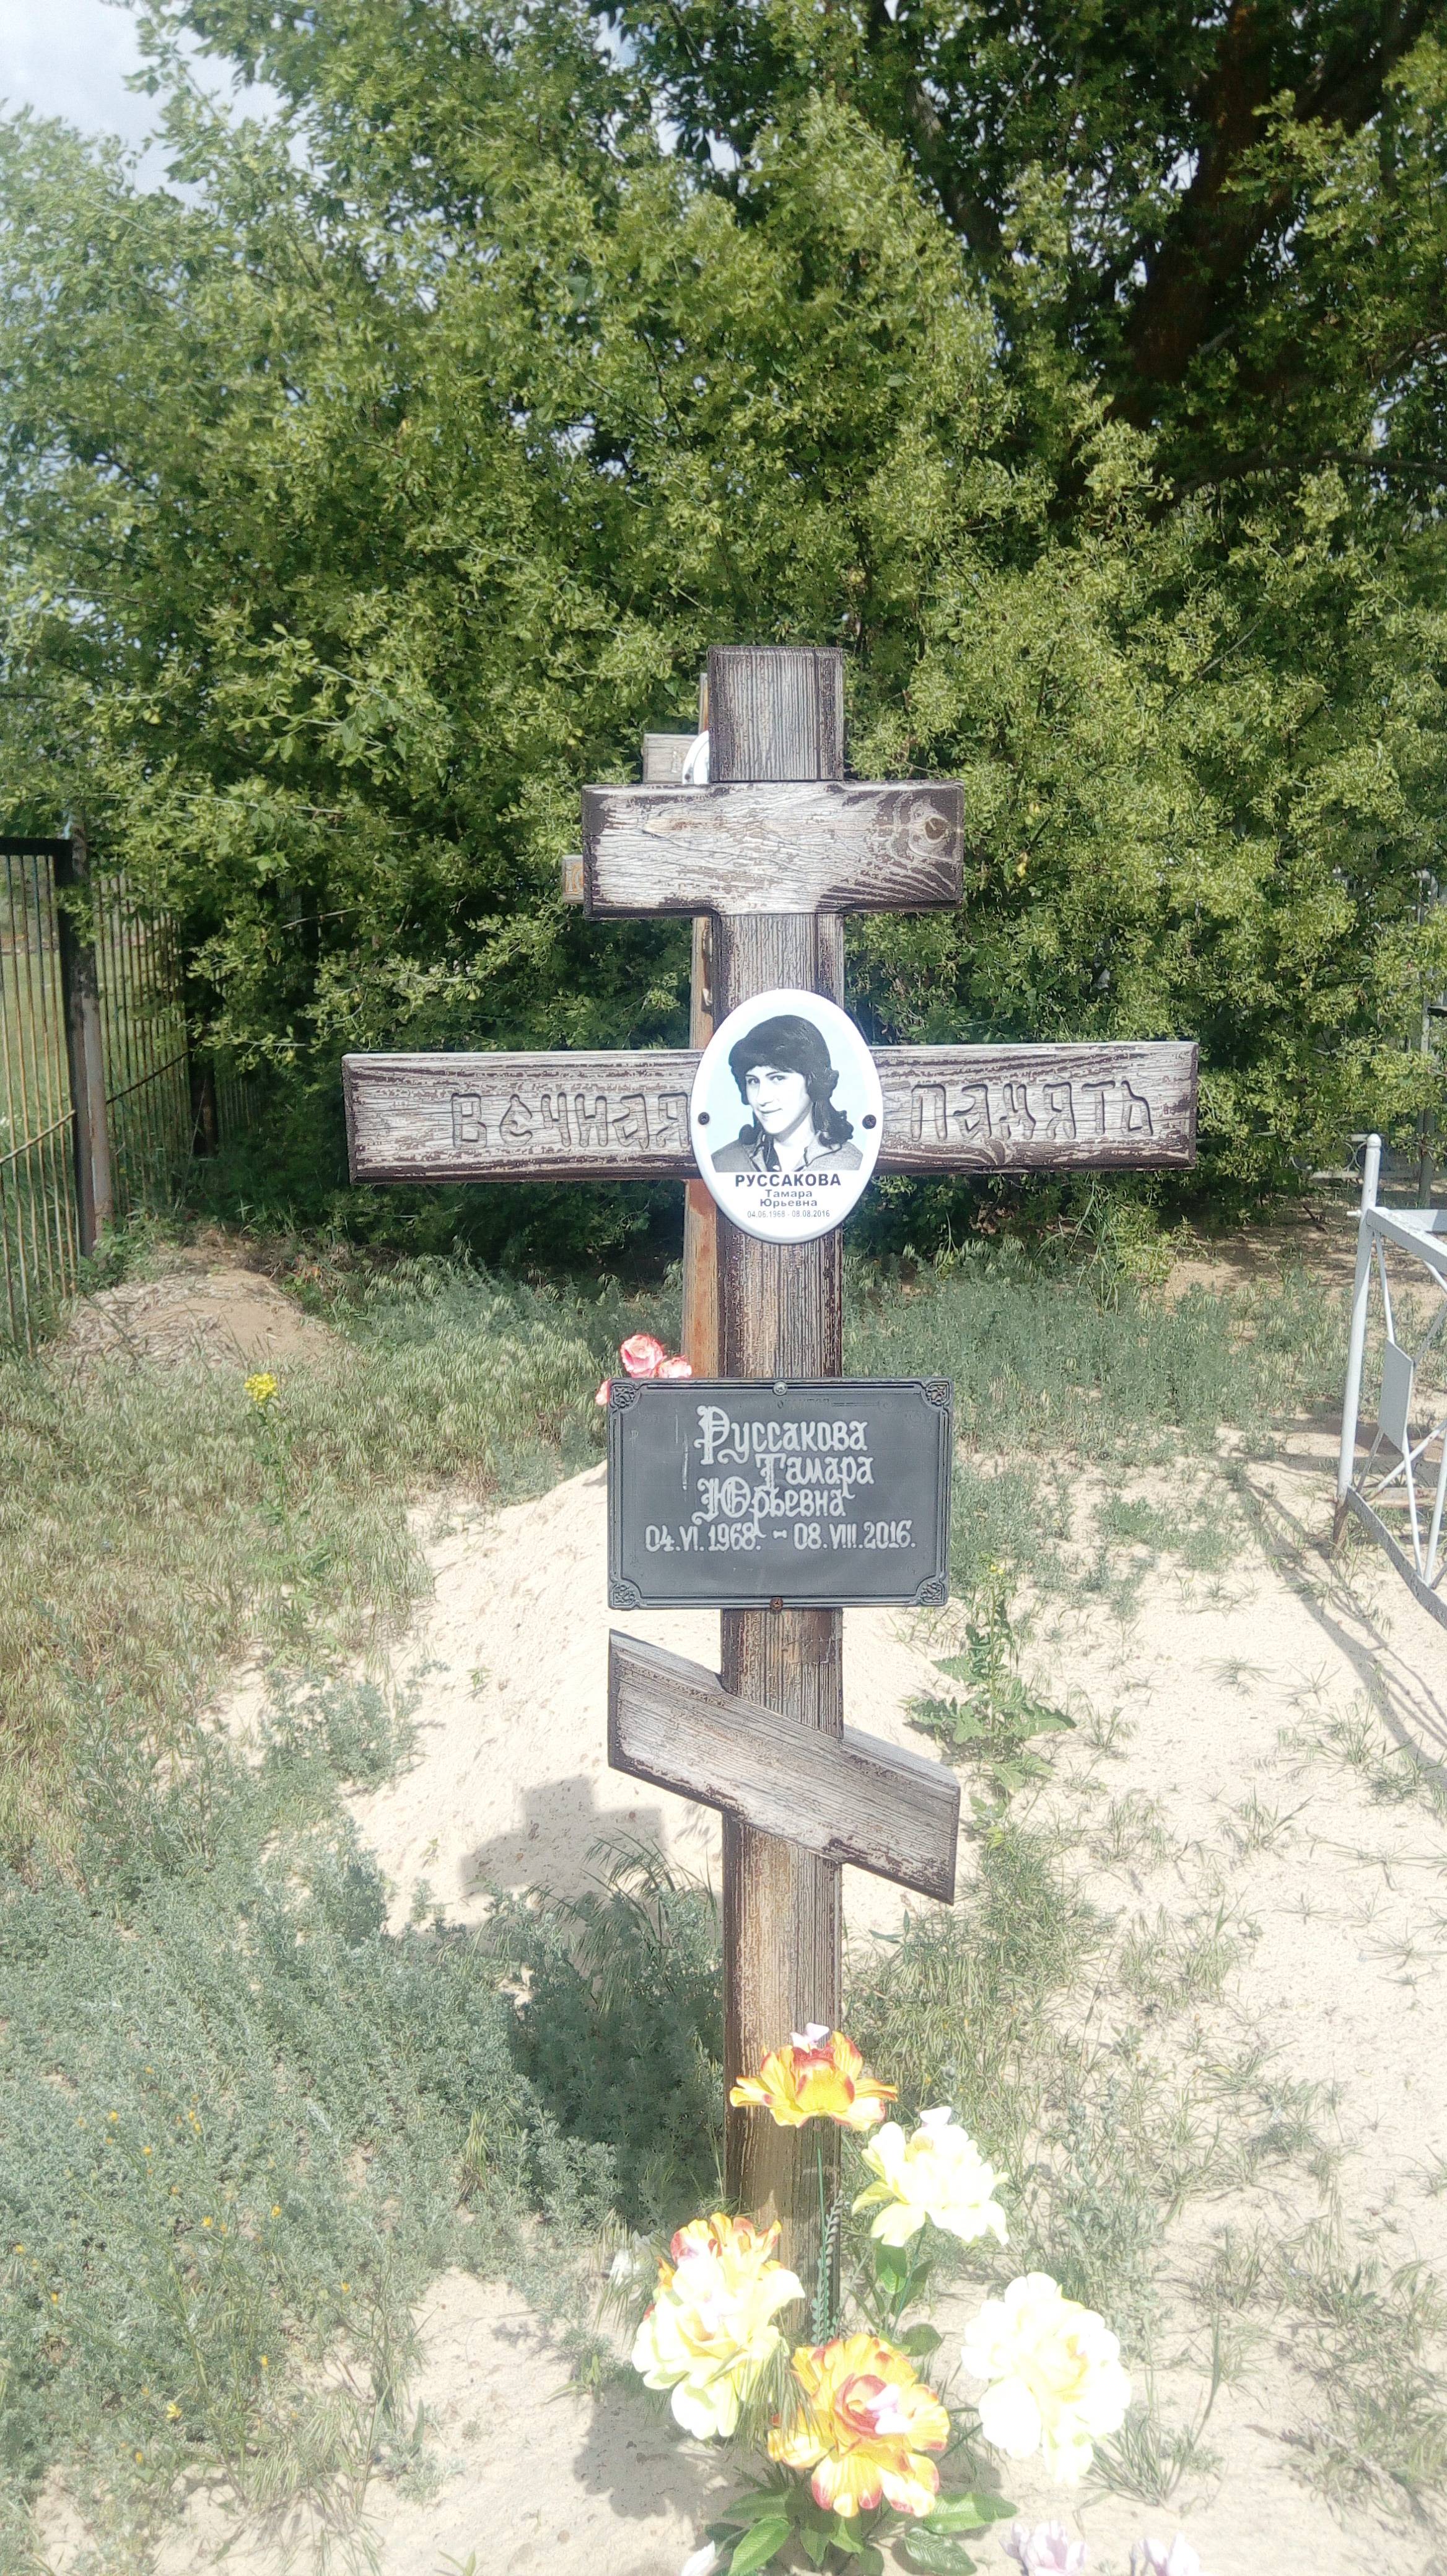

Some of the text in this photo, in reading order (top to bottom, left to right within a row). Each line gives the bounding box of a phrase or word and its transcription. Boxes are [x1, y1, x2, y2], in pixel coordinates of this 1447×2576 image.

[735, 1173, 841, 1187] РУССАКОВА
[765, 1189, 813, 1199] Тамара
[760, 1198, 818, 1208] Юрьевна
[694, 1405, 868, 1465] Руссакова
[755, 1453, 874, 1499] Тамара
[692, 1476, 846, 1538] Юрьевна
